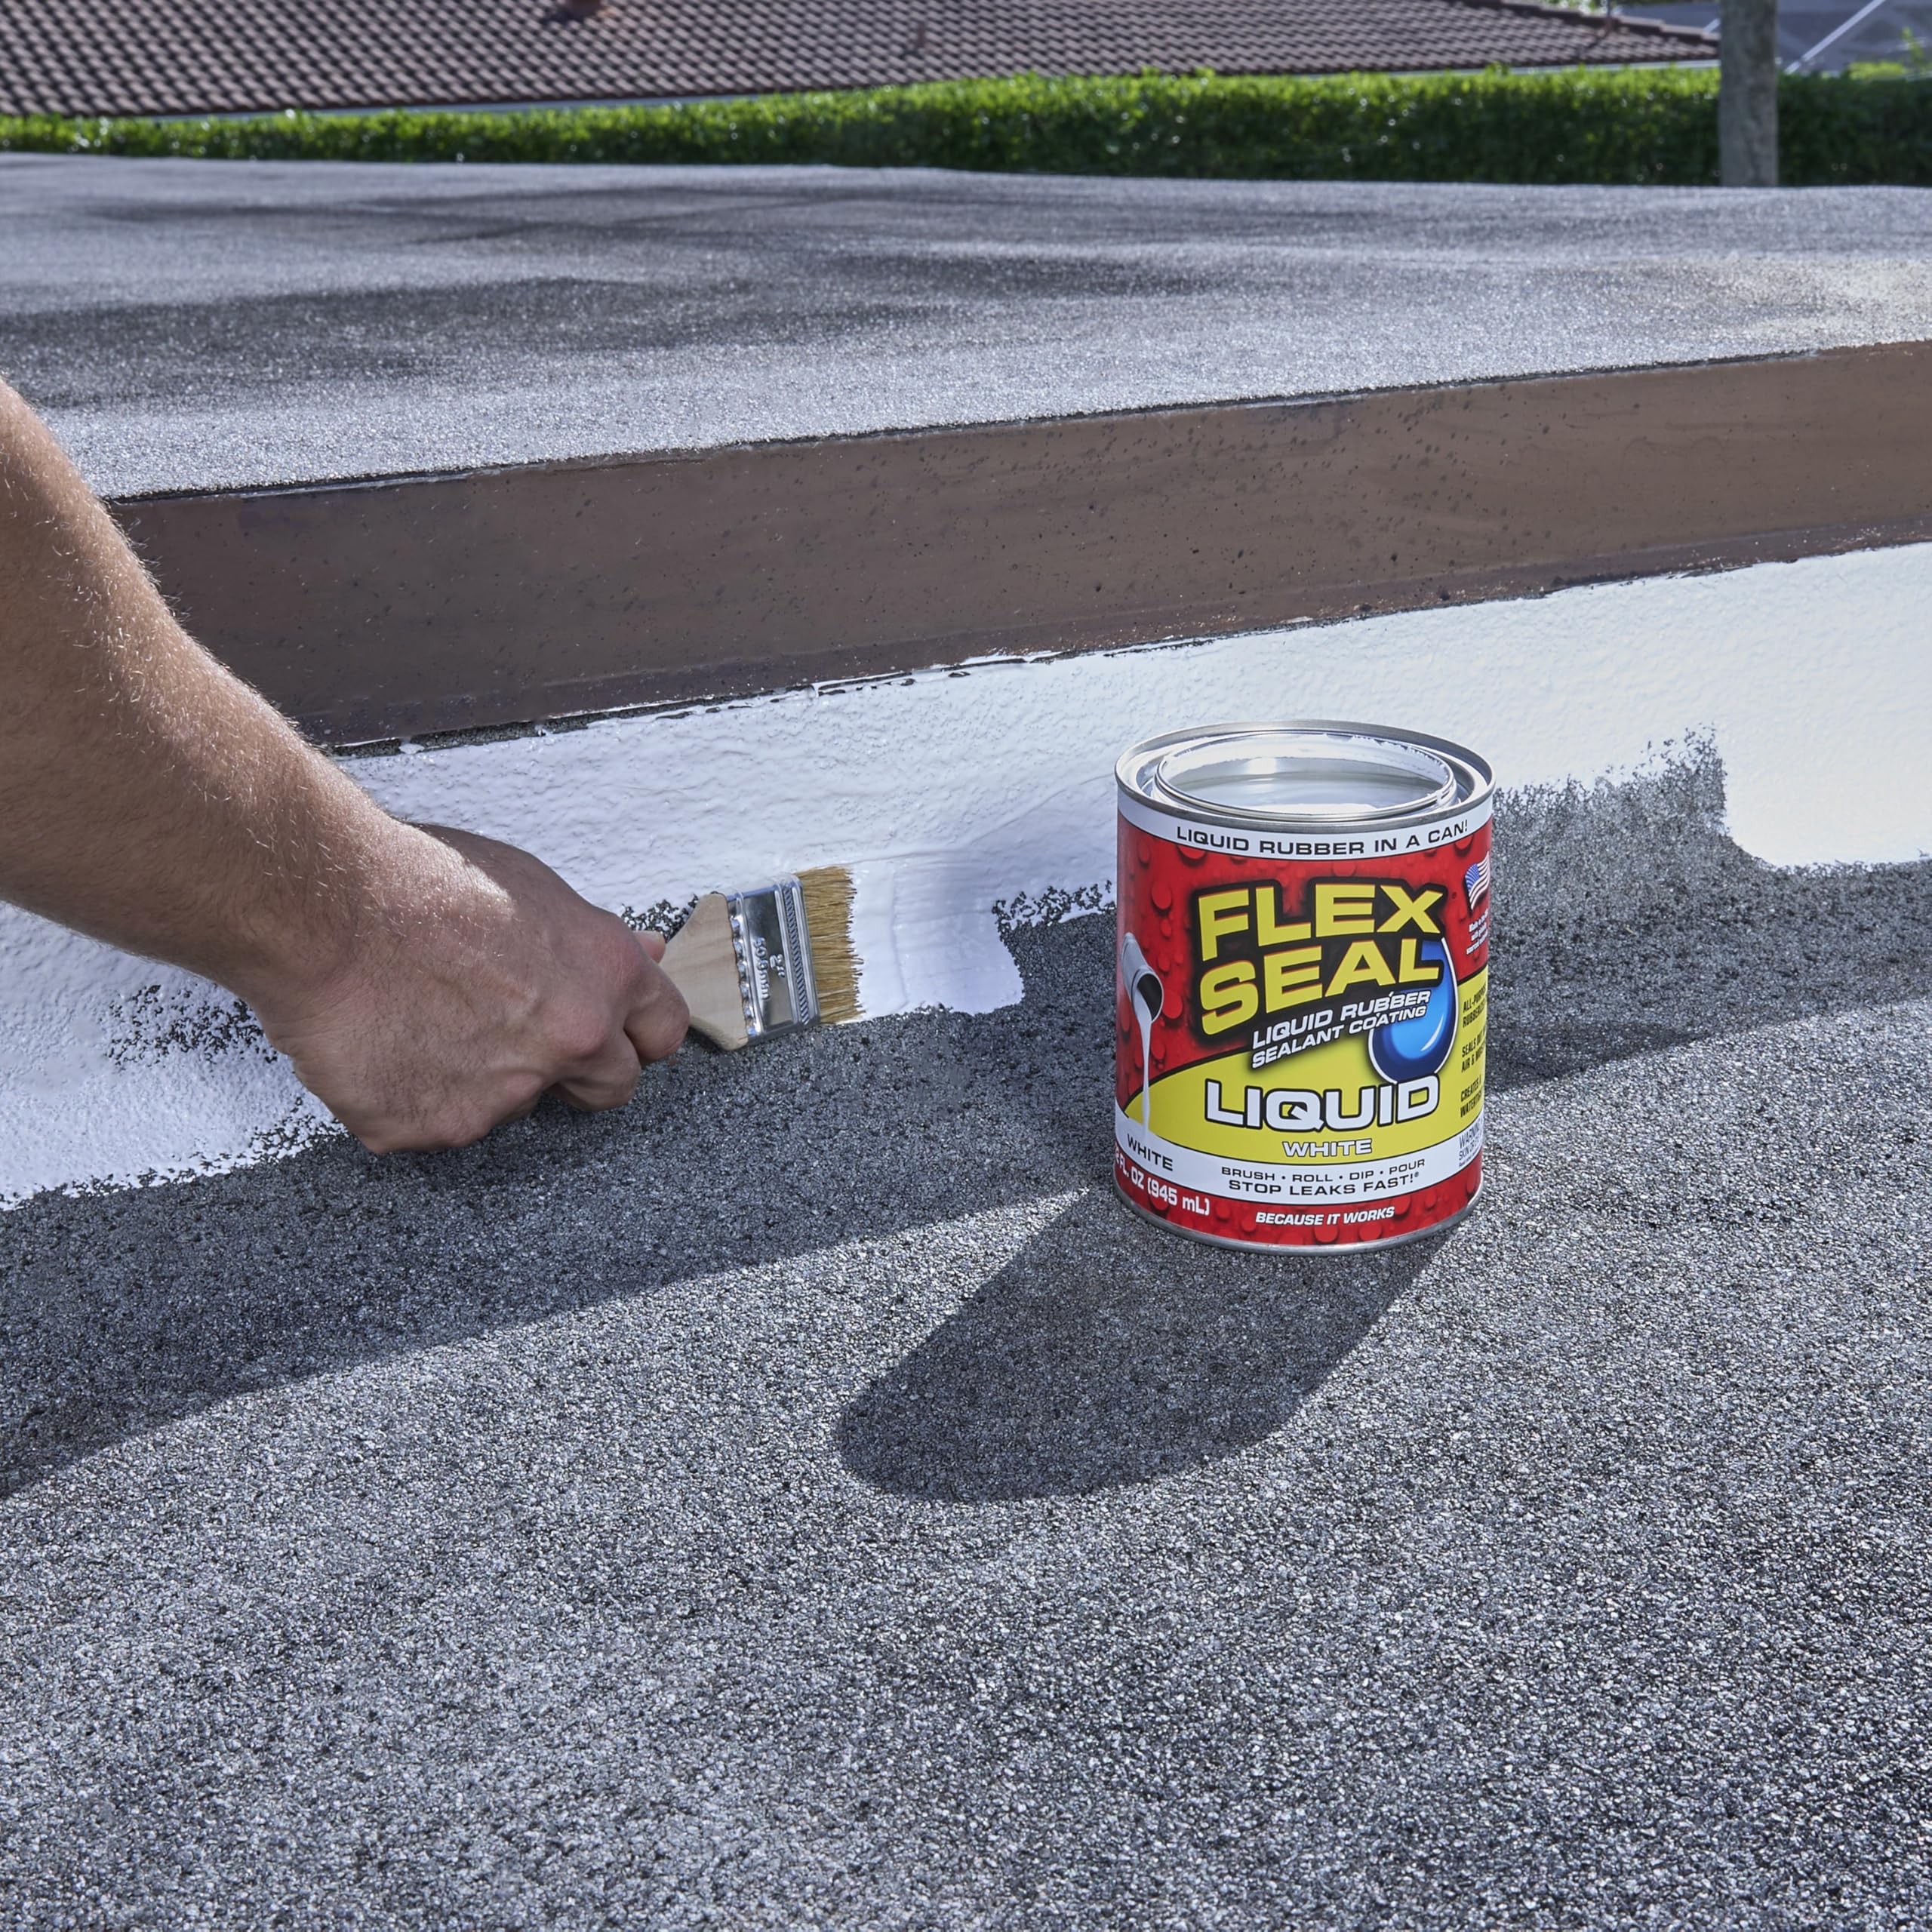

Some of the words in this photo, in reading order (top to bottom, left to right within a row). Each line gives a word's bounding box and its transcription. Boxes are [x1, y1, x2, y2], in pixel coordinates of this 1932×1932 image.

[1177, 826, 1250, 852] LIQUID
[1259, 840, 1364, 855] RUBBER
[1374, 838, 1397, 853] IN
[1405, 835, 1421, 849] A
[1427, 820, 1468, 844] CAN!
[1198, 883, 1444, 961] FLEX
[1198, 938, 1440, 1035] SEAL
[1251, 1024, 1344, 1069] SEALANT
[1349, 1005, 1427, 1035] COATING
[1253, 1009, 1334, 1050] LIQUID
[1340, 989, 1431, 1021] RUBBER
[1462, 1037, 1476, 1058] SEALS
[1206, 1072, 1440, 1132] LIQUID
[1127, 1134, 1174, 1172] WHITE
[1282, 1138, 1373, 1158] WHITE
[1221, 1166, 1275, 1181] BRUSH
[1292, 1173, 1334, 1183] ROLL
[1349, 1170, 1374, 1180] DIP
[1389, 1158, 1426, 1175] POUR
[1229, 1180, 1281, 1195] STOP
[1290, 1184, 1356, 1196] LEAKS
[1131, 1166, 1144, 1190] OZ
[1147, 1177, 1178, 1206] (945
[1182, 1196, 1211, 1216] mL)
[1255, 1211, 1324, 1226] BECAUSE
[1327, 1214, 1340, 1225] IT
[1343, 1206, 1395, 1224] WORKS
